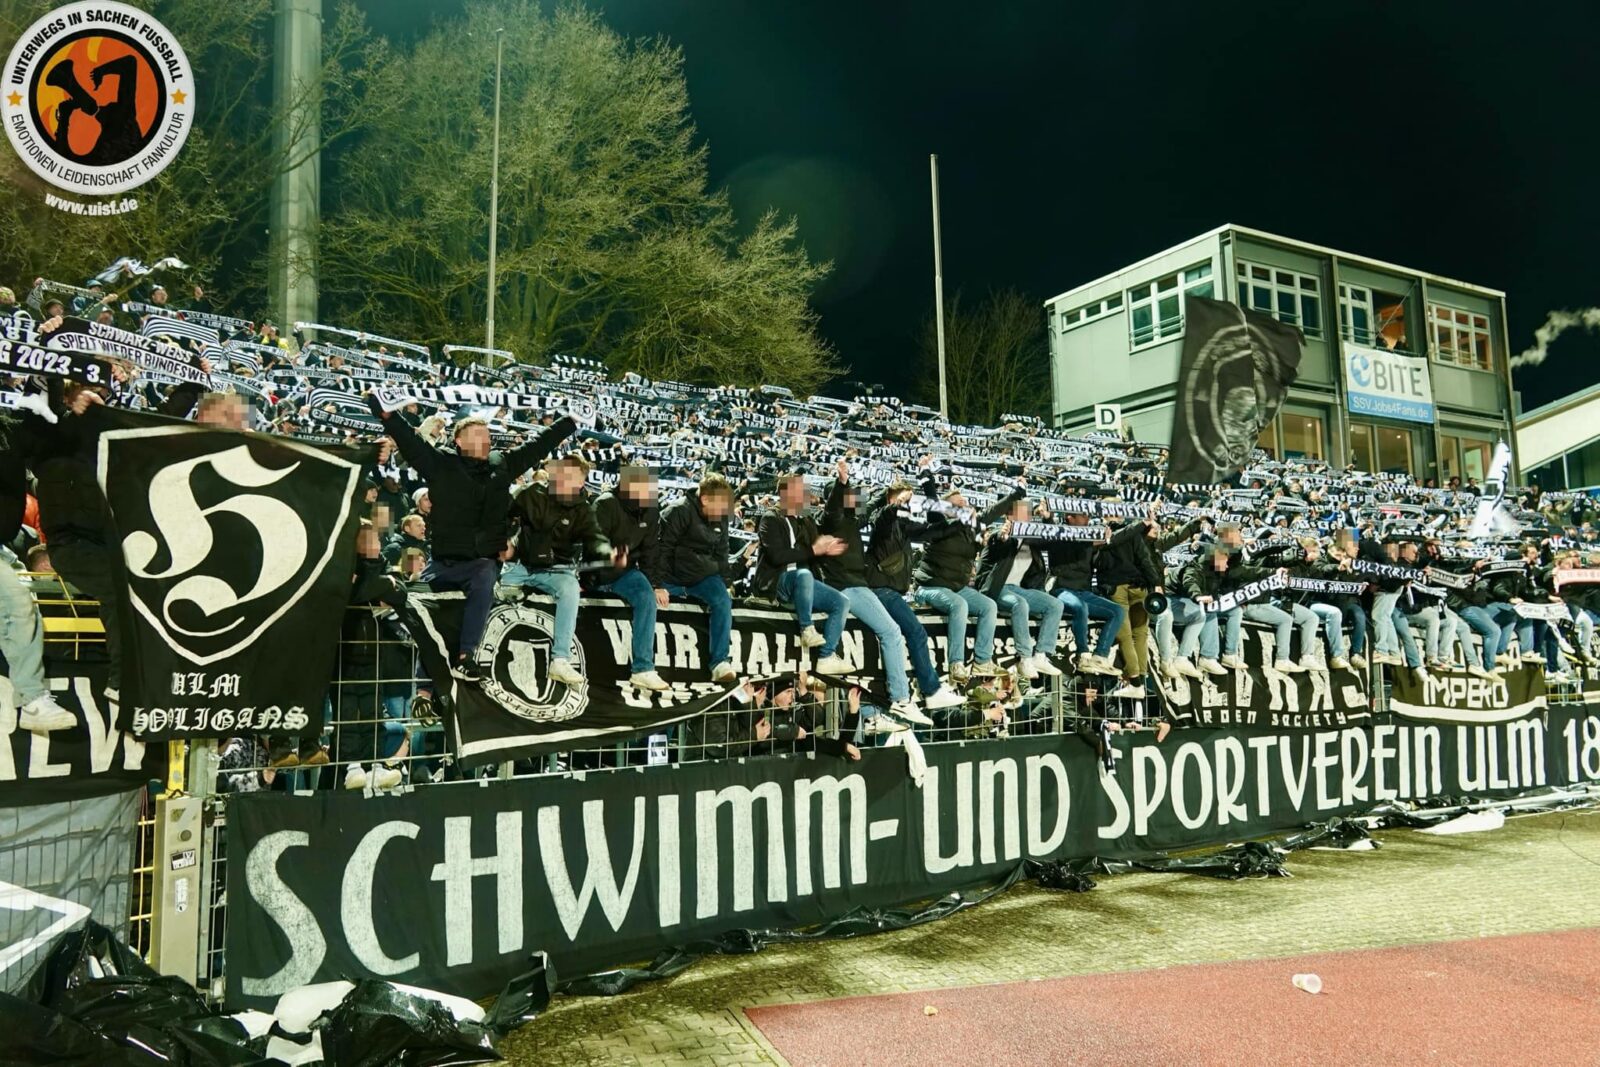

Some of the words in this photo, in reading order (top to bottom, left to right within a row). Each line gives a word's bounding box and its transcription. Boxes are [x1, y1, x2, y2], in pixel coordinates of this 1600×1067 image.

[57, 334, 97, 352] SPIELT
[99, 340, 143, 367] WIEDER
[89, 321, 193, 363] SCHWARZ-WEISS
[16, 344, 72, 376] 2023
[1374, 360, 1424, 397] BITE
[415, 386, 564, 410] ULMER
[1101, 409, 1115, 425] D
[1050, 498, 1096, 514] BROKEN
[601, 618, 701, 670] WIR
[728, 629, 864, 676] HALTN
[171, 672, 241, 698] ULM
[133, 705, 309, 736] HOLIGANS
[241, 772, 899, 996] SCHWIMM-
[923, 752, 1070, 875] UND
[1098, 723, 1442, 840] SPORTVEREIN
[1457, 718, 1547, 791] ULM
